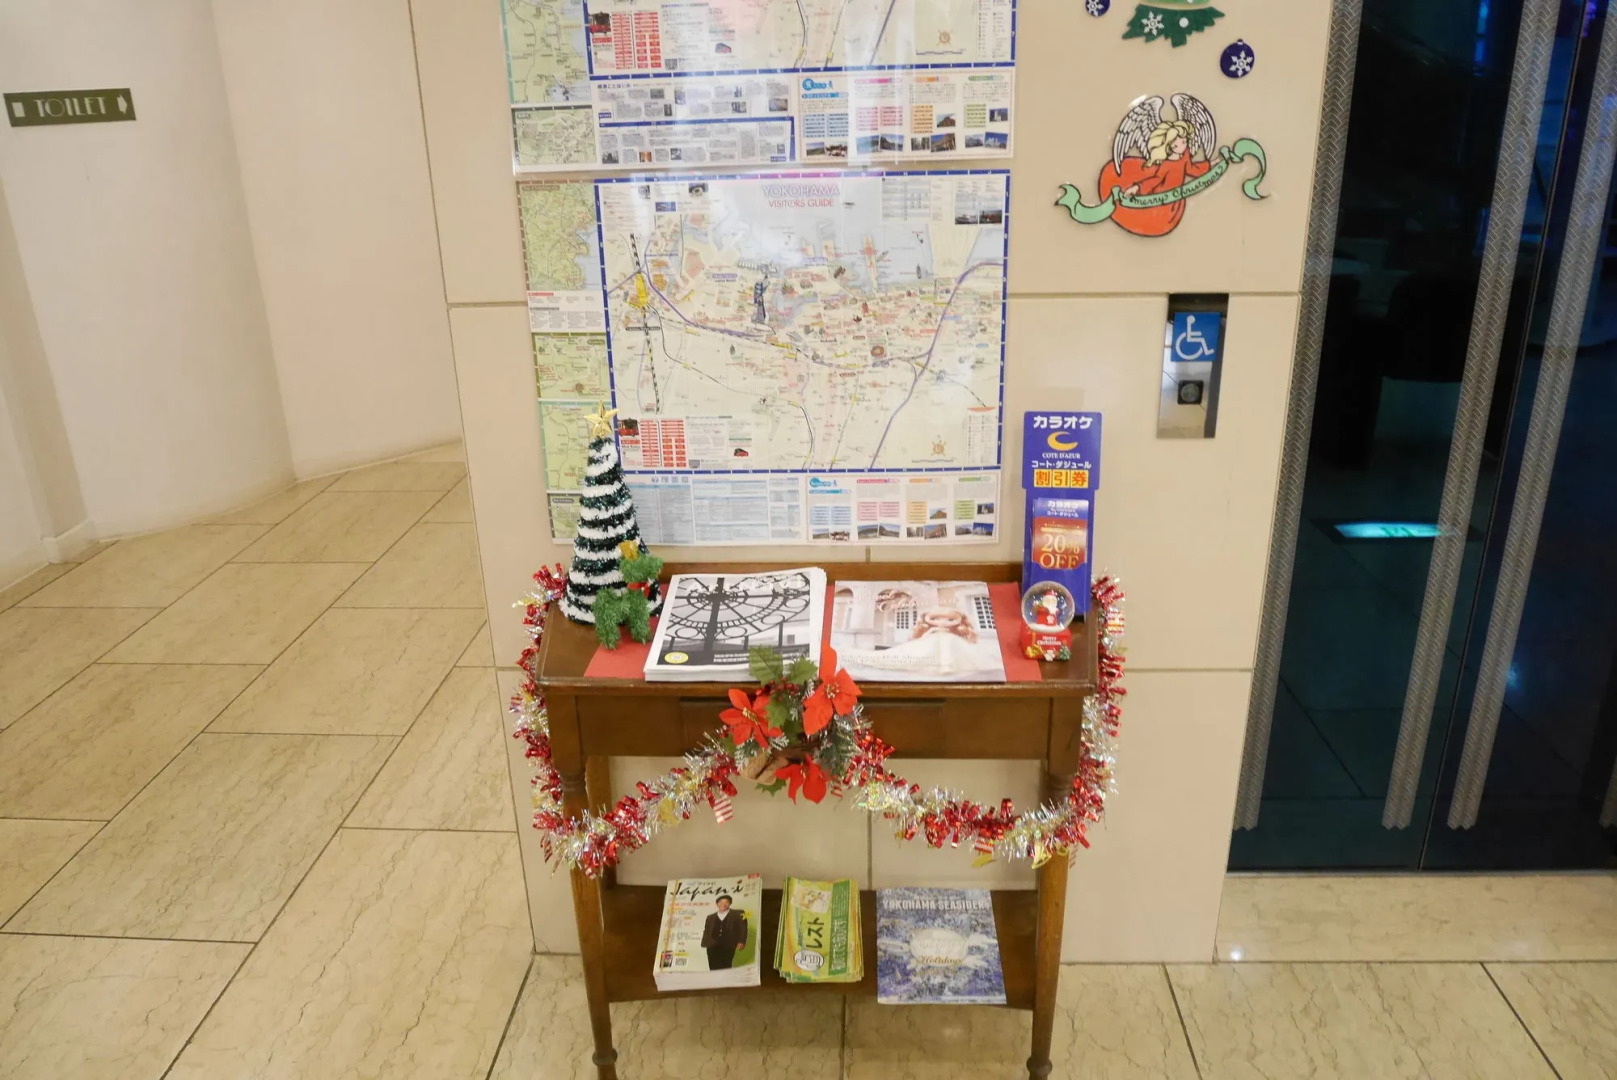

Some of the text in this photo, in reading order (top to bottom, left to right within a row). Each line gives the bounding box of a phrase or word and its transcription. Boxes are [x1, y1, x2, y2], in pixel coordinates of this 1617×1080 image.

[34, 96, 107, 118] TOILET
[762, 183, 840, 198] YOKOHAMA
[1172, 166, 1223, 198] Christmas
[769, 198, 833, 207] VISITORS GUIDE
[1033, 416, 1093, 430] カラオケ
[1031, 460, 1092, 470] コート・ダジュール
[1035, 470, 1087, 487] 割引券
[1041, 533, 1080, 554] 20%
[1040, 552, 1079, 569] OFF
[883, 899, 936, 910] YOKOHAMA
[806, 917, 825, 949] レスト
